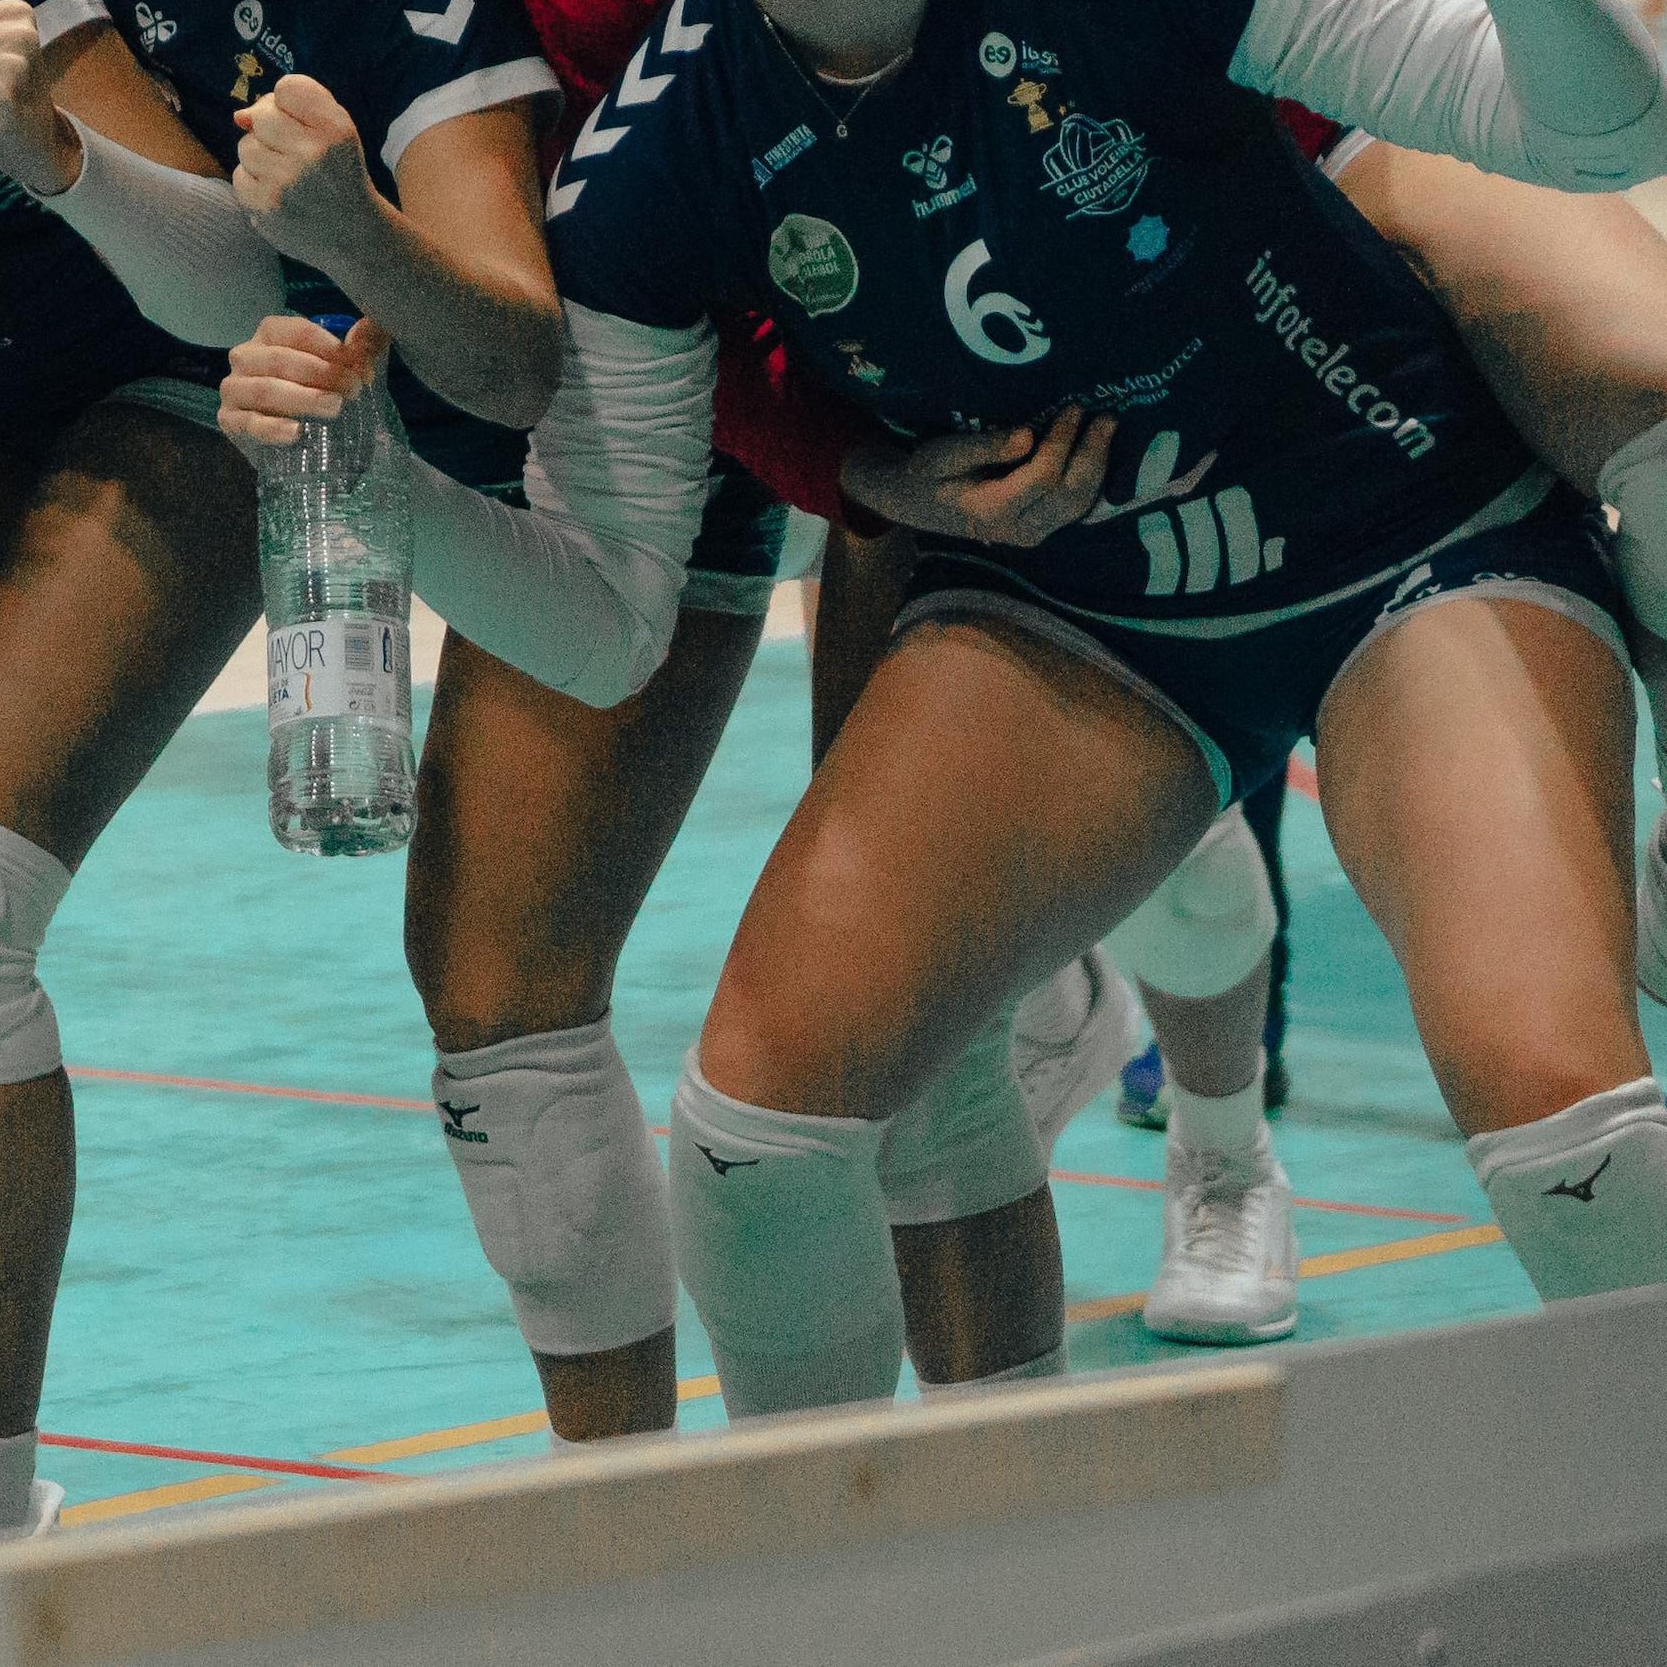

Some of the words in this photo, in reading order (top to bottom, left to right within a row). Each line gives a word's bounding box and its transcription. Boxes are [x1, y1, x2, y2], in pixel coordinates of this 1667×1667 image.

[912, 173, 978, 219] hummel
[944, 238, 1051, 365] 6
[1247, 250, 1438, 460] infotelecom
